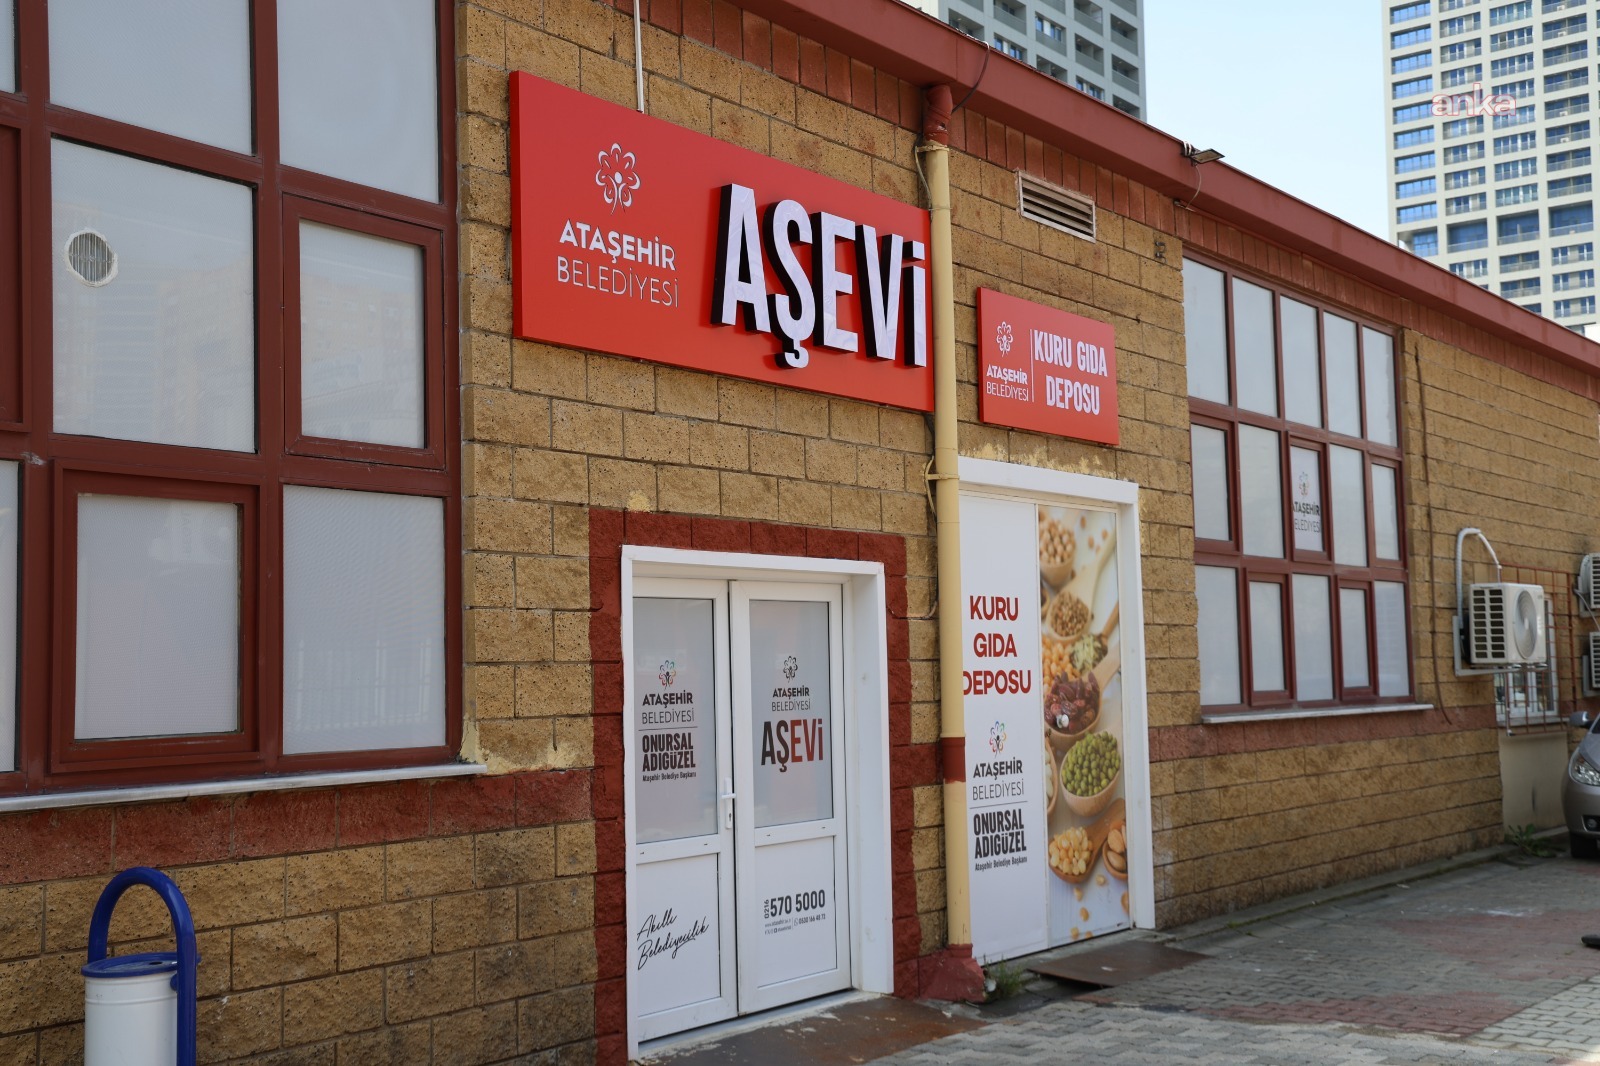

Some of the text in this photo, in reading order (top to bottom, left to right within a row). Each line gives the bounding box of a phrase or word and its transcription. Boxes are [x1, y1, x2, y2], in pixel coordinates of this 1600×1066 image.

[559, 218, 676, 271] ATAŞEHİR
[557, 255, 679, 308] BELEDİYESİ
[1034, 329, 1108, 377] KURU GIDA
[986, 363, 1028, 385] ATAŞEHİR
[986, 381, 1029, 402] BELEDİYESİ
[1045, 374, 1100, 416] DEPOSU
[969, 595, 1019, 622] KURU
[973, 632, 1018, 658] GIDA
[642, 690, 693, 708] ATAŞEHİR
[772, 685, 810, 700] ATAŞEHİR
[642, 708, 694, 724] BELEDİYESİ
[771, 699, 811, 712] BELEDİYESİ
[642, 732, 694, 753] ONURSAL
[642, 751, 696, 772] ADIGÜZEL
[973, 757, 1023, 780] ATAŞEHİR
[972, 778, 1025, 801] BELEDİYESİ
[973, 808, 1024, 836] ONURSAL
[975, 830, 1027, 859] ADIGÜZEL
[770, 895, 792, 917] 570
[795, 889, 826, 912] 5000
